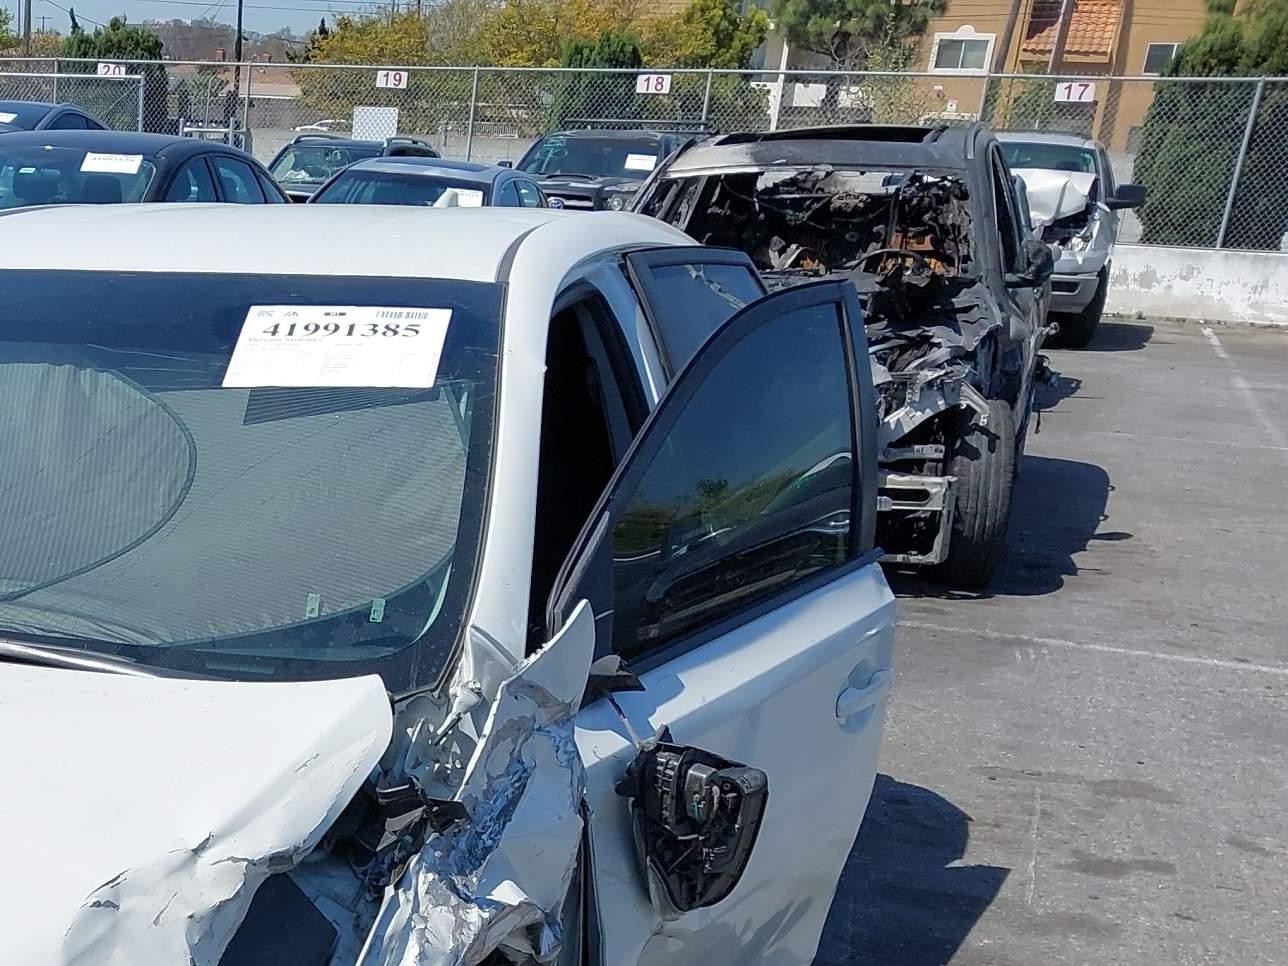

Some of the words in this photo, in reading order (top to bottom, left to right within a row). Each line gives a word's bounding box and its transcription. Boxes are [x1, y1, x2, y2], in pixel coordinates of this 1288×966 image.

[102, 64, 122, 75] 20
[382, 71, 403, 87] 19
[642, 76, 665, 92] 18
[1064, 84, 1090, 100] 17
[261, 321, 423, 338] 41991385
